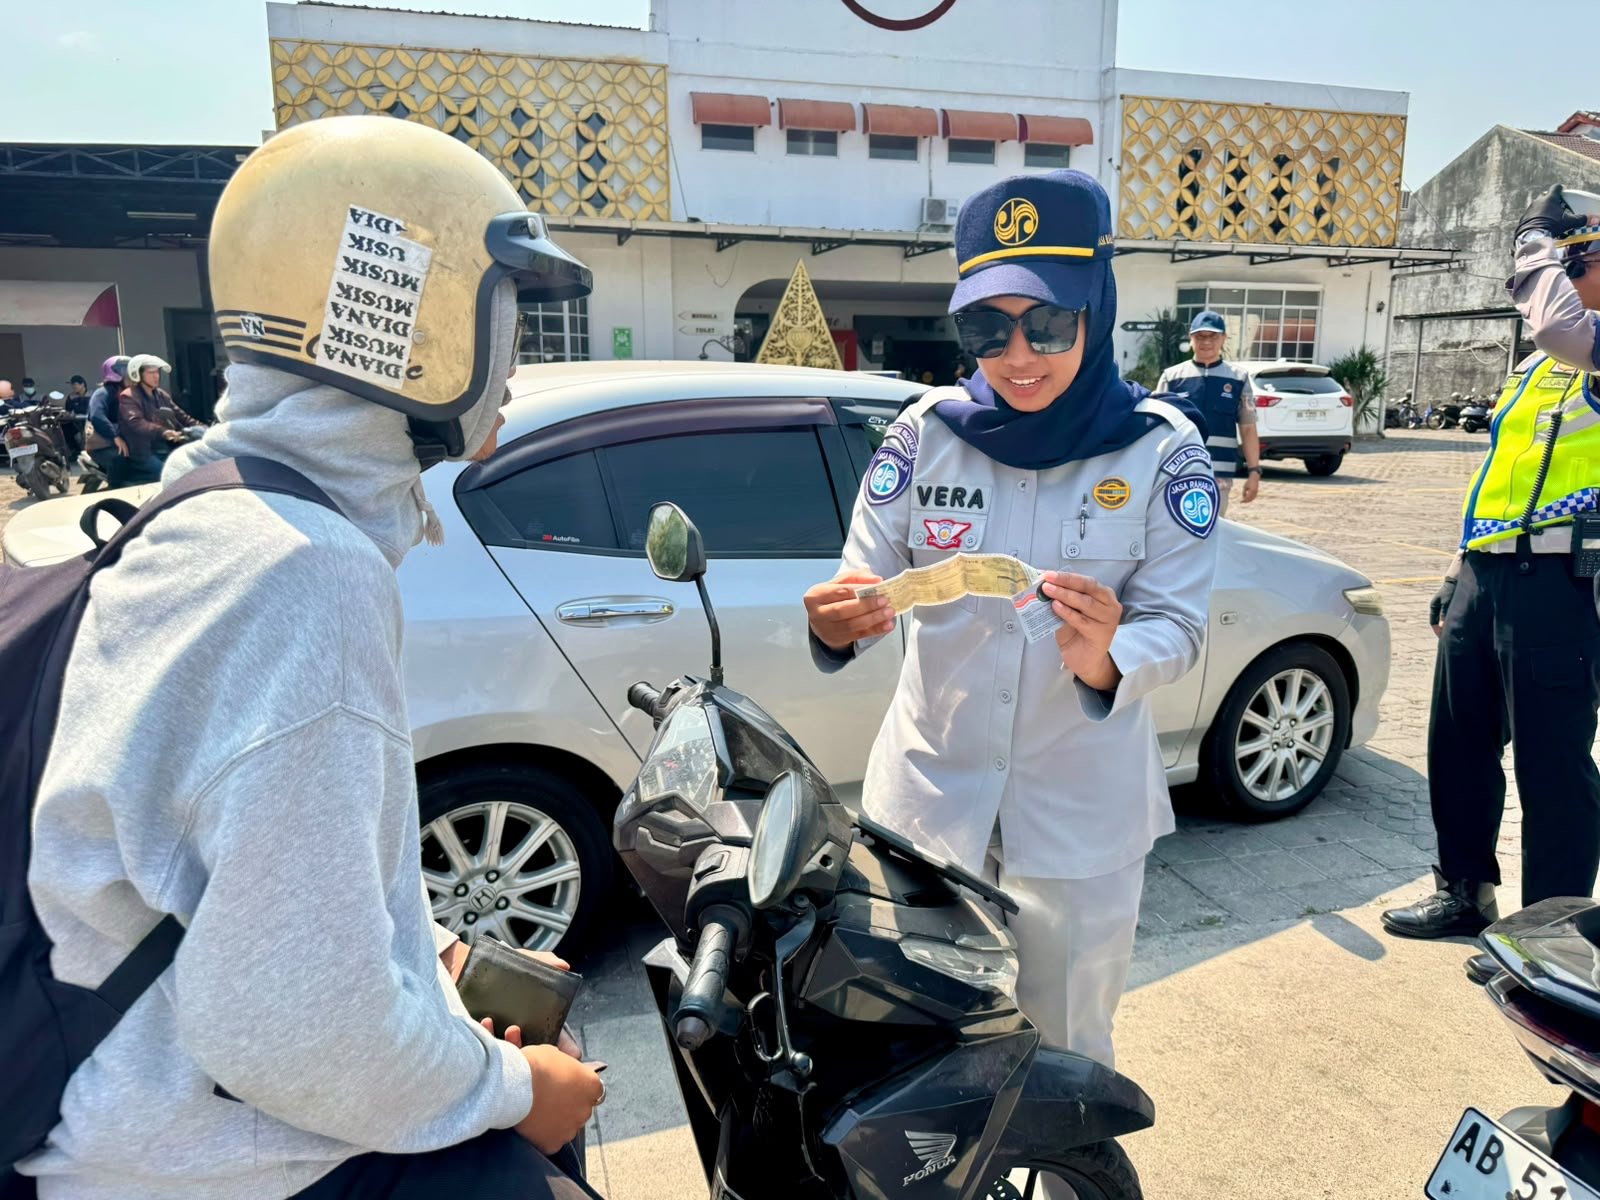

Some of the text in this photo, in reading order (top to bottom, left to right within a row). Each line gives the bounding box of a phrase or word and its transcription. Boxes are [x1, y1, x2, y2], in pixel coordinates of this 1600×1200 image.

[342, 255, 420, 292] MUSIK
[336, 281, 414, 318] MUSIK
[330, 301, 411, 338] DIANA
[327, 324, 406, 360] MUSIK
[323, 343, 403, 380] DIANA
[916, 485, 984, 510] VERA
[1170, 480, 1188, 495] JASA
[1453, 1121, 1505, 1176] AB
